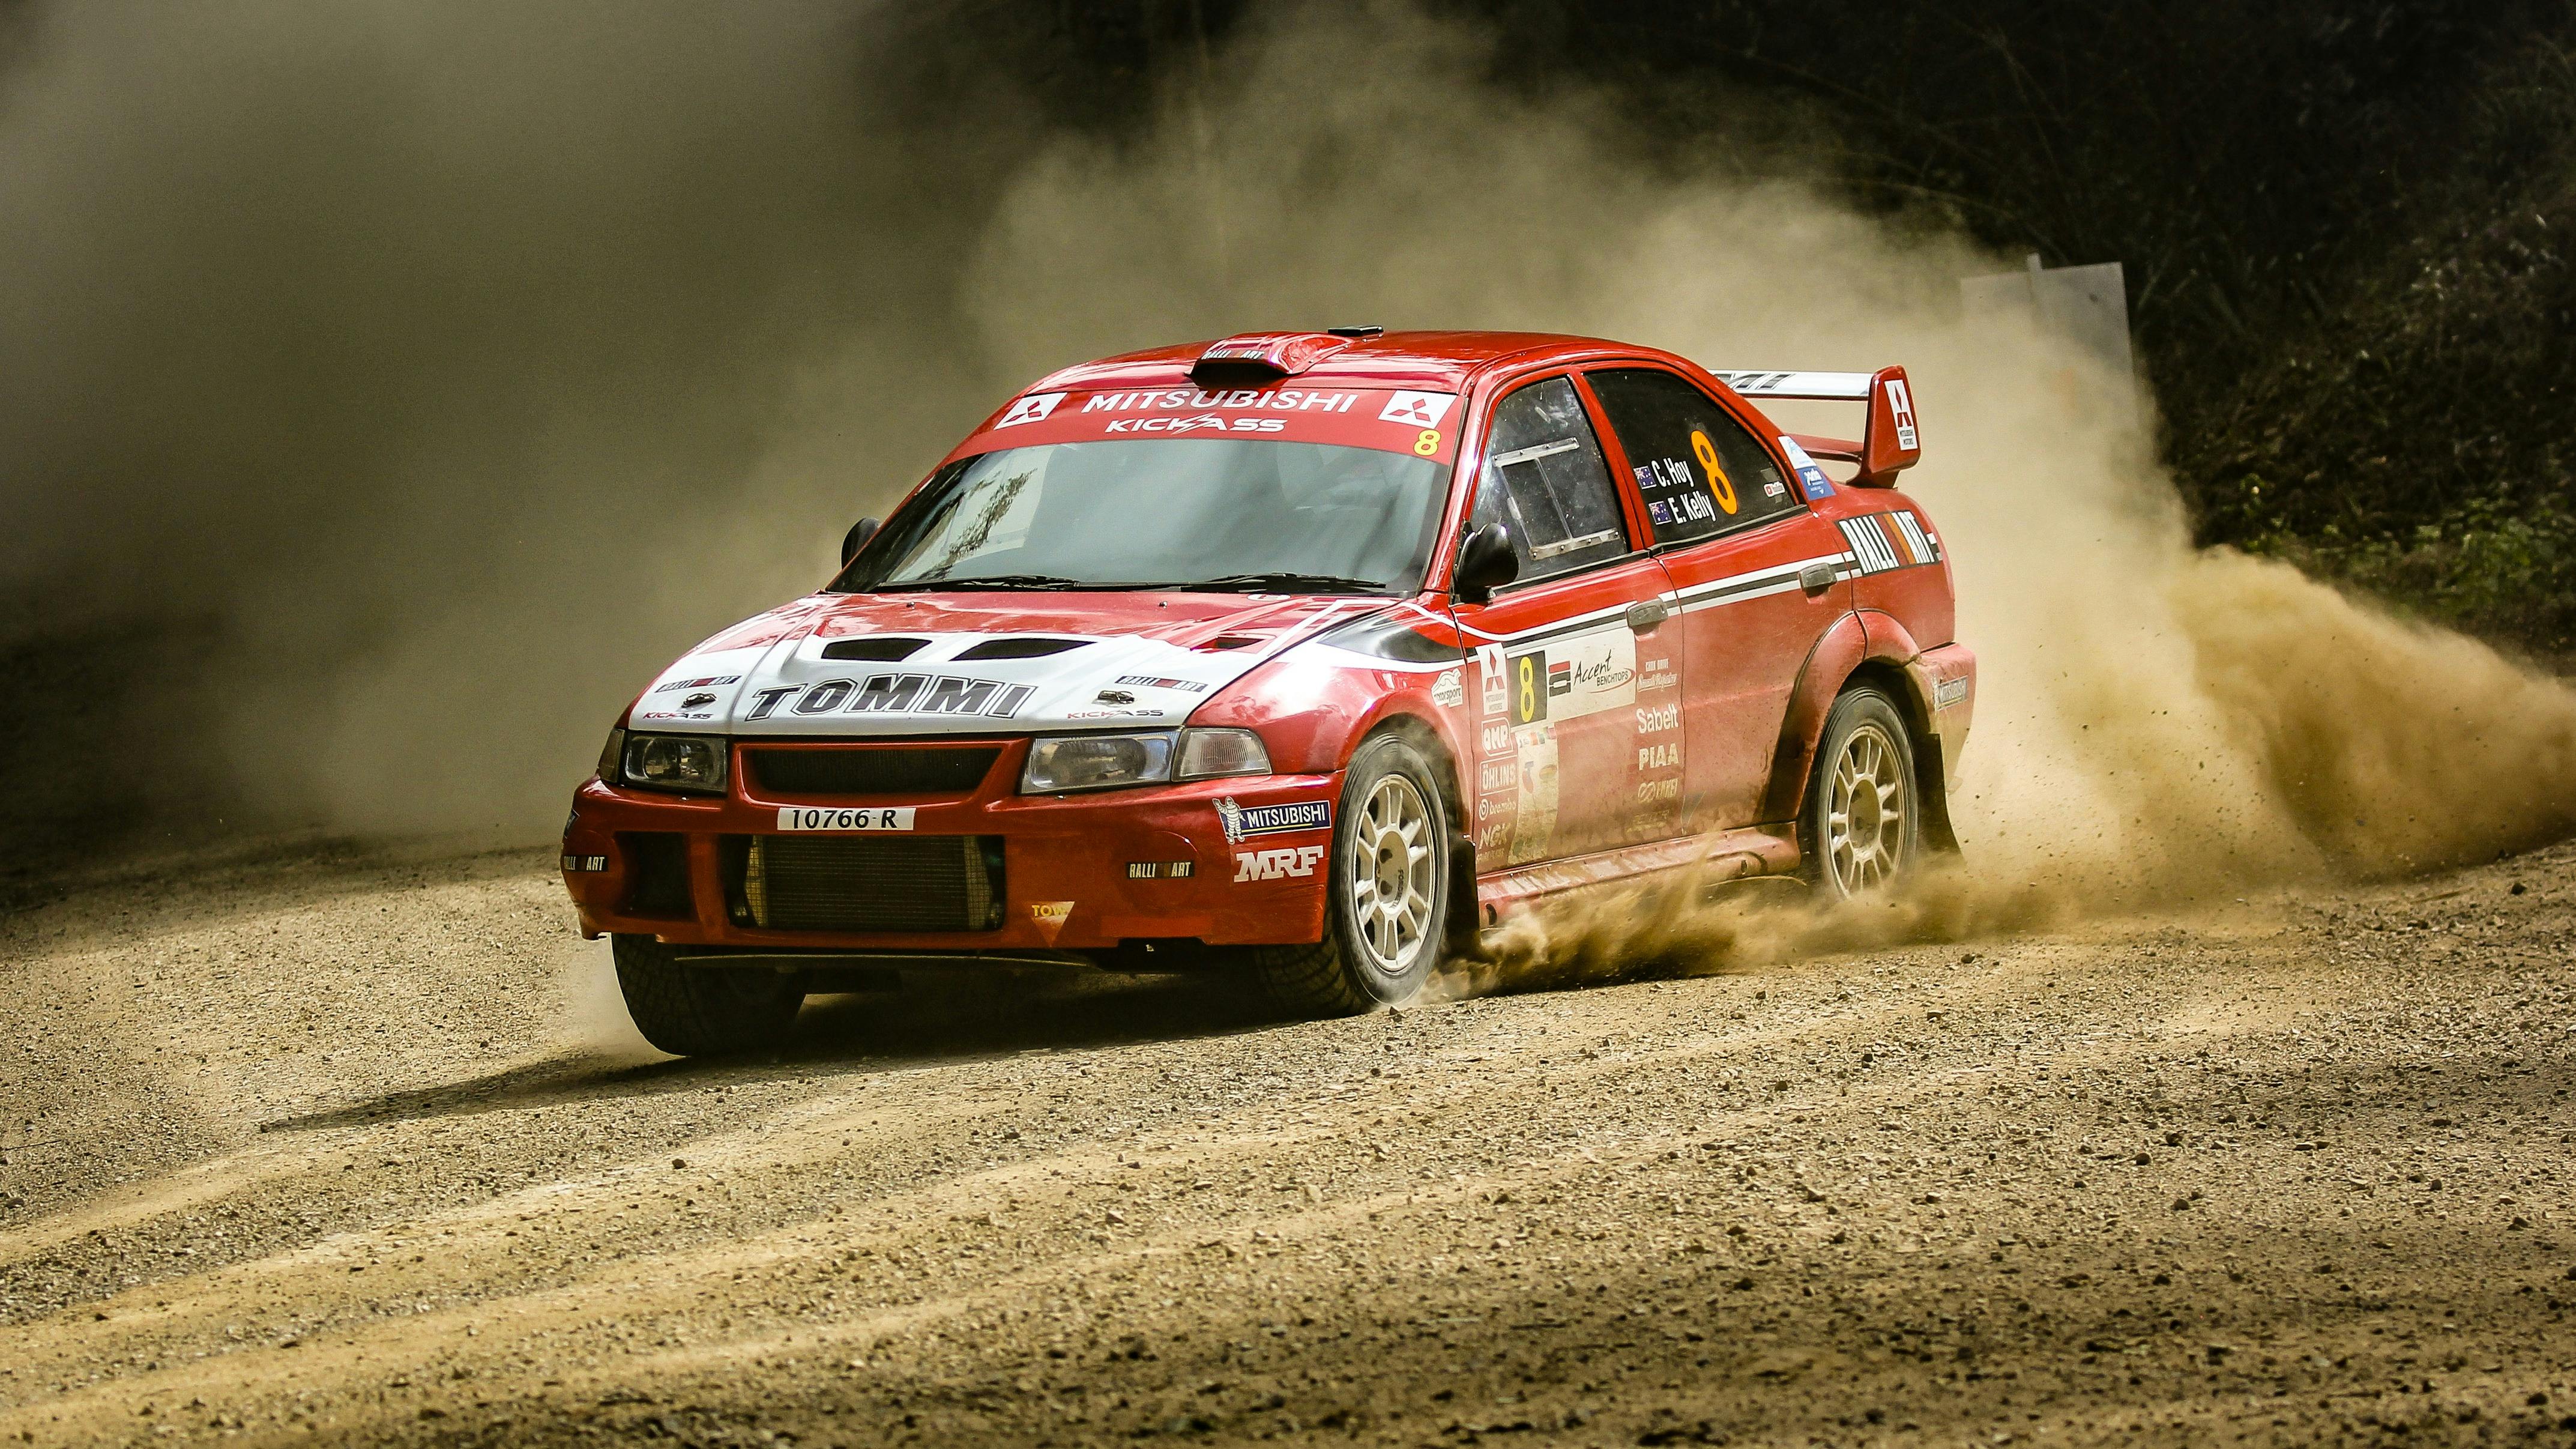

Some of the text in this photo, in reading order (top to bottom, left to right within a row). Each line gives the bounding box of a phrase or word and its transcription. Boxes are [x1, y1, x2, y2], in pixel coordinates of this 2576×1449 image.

[1081, 390, 1359, 413] MITSUBISHI
[1105, 413, 1288, 435] KICKASS
[1413, 429, 1441, 456] 8
[1651, 457, 1695, 488] C. Hoy
[1691, 429, 1738, 515] 8
[1667, 490, 1717, 524] E. Kelly
[1573, 649, 1612, 686] Accent
[1596, 670, 1629, 687] BENCHTOPS
[745, 673, 1039, 721] TOMMI
[1518, 656, 1535, 722] 8
[1636, 703, 1679, 734] Sabelt
[1483, 724, 1509, 751] OMP
[1638, 742, 1679, 771] PIAA
[1246, 804, 1326, 828] MITSUBISHI
[1489, 797, 1516, 815] brembo
[586, 856, 605, 871] ART
[1129, 862, 1191, 878] RALLI ART
[1234, 845, 1324, 883] MRF
